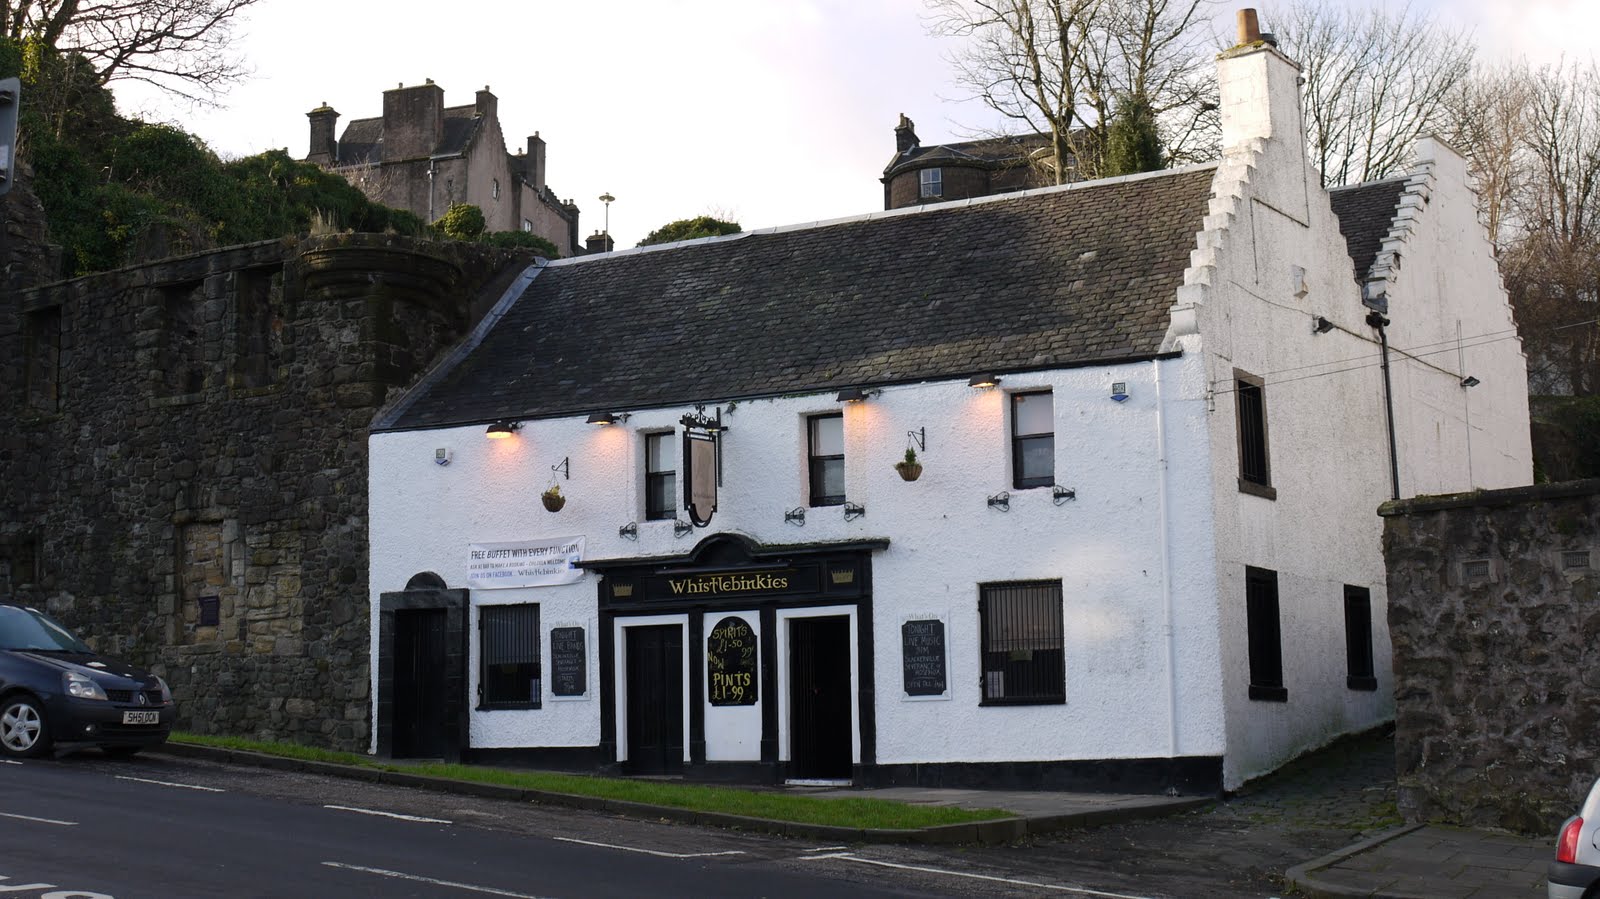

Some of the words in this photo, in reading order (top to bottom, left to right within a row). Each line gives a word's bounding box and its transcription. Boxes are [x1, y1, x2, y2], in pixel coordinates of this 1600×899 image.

[471, 550, 486, 560] FREE
[487, 549, 510, 559] BUFFET
[511, 548, 528, 558] WITH
[528, 546, 548, 557] EVERY
[668, 573, 788, 595] Whistlebinkies
[712, 624, 748, 640] SPIRITS
[904, 624, 936, 635] TONIGHT
[707, 651, 725, 669] NOW
[713, 671, 751, 687] PINTS
